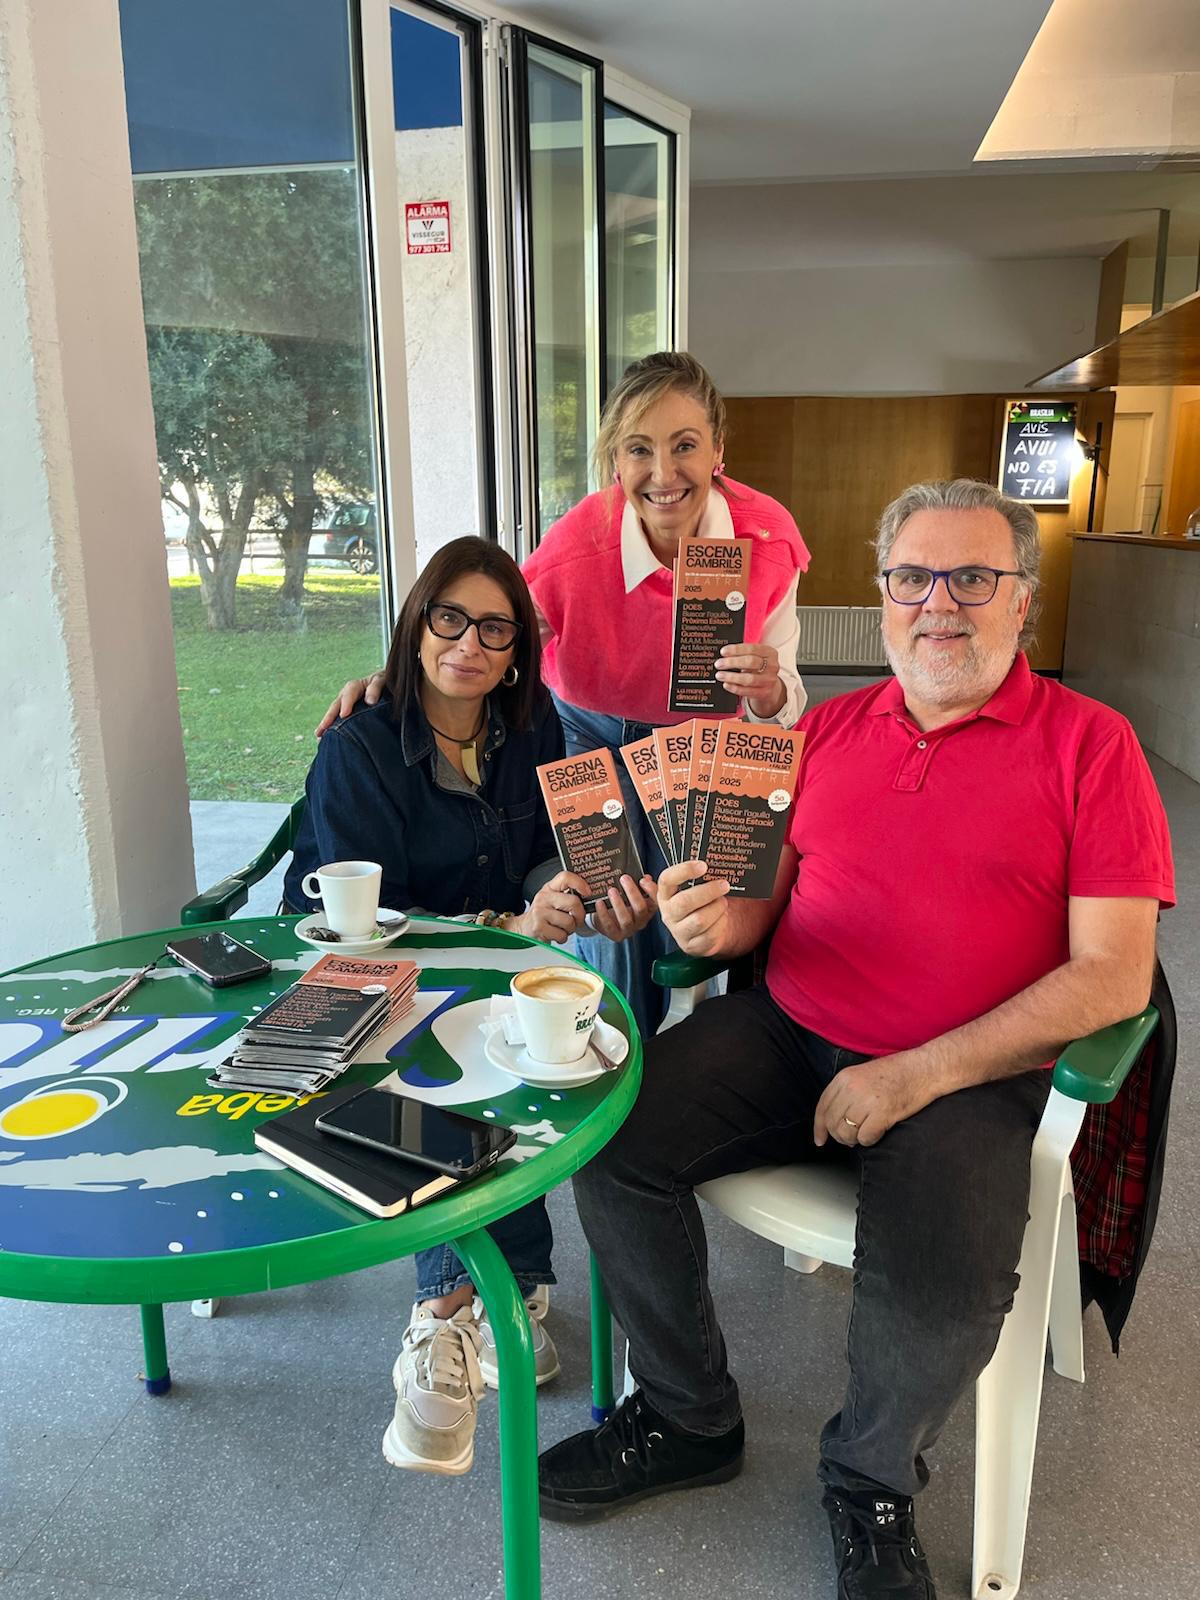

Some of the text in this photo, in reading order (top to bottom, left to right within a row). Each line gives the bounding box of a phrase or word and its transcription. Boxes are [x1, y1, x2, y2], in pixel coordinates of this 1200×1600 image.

[408, 206, 448, 217] ALARMA
[1007, 461, 1030, 473] NO
[686, 545, 742, 558] ESCENA
[685, 558, 742, 568] CAMBRILS
[679, 650, 714, 658] Impossible
[726, 731, 795, 753] ESCENA
[724, 745, 793, 764] CAMBRILS
[545, 756, 604, 783] ESCENA
[720, 767, 789, 784] TEATRE
[549, 768, 607, 793] CAMBRILS
[719, 777, 741, 786] 2025
[714, 798, 739, 808] DOES
[556, 805, 575, 816] 2025
[714, 805, 743, 816] Buscar
[561, 822, 582, 834] DOES
[745, 817, 774, 827] Estació
[592, 825, 617, 839] Estació
[710, 828, 749, 840] Guateque
[735, 838, 766, 848] Modern
[569, 844, 602, 861] Guateque
[593, 846, 620, 860] Modern
[722, 845, 752, 854] Modern
[706, 851, 747, 862] Impossible
[573, 856, 611, 873] Art Modern
